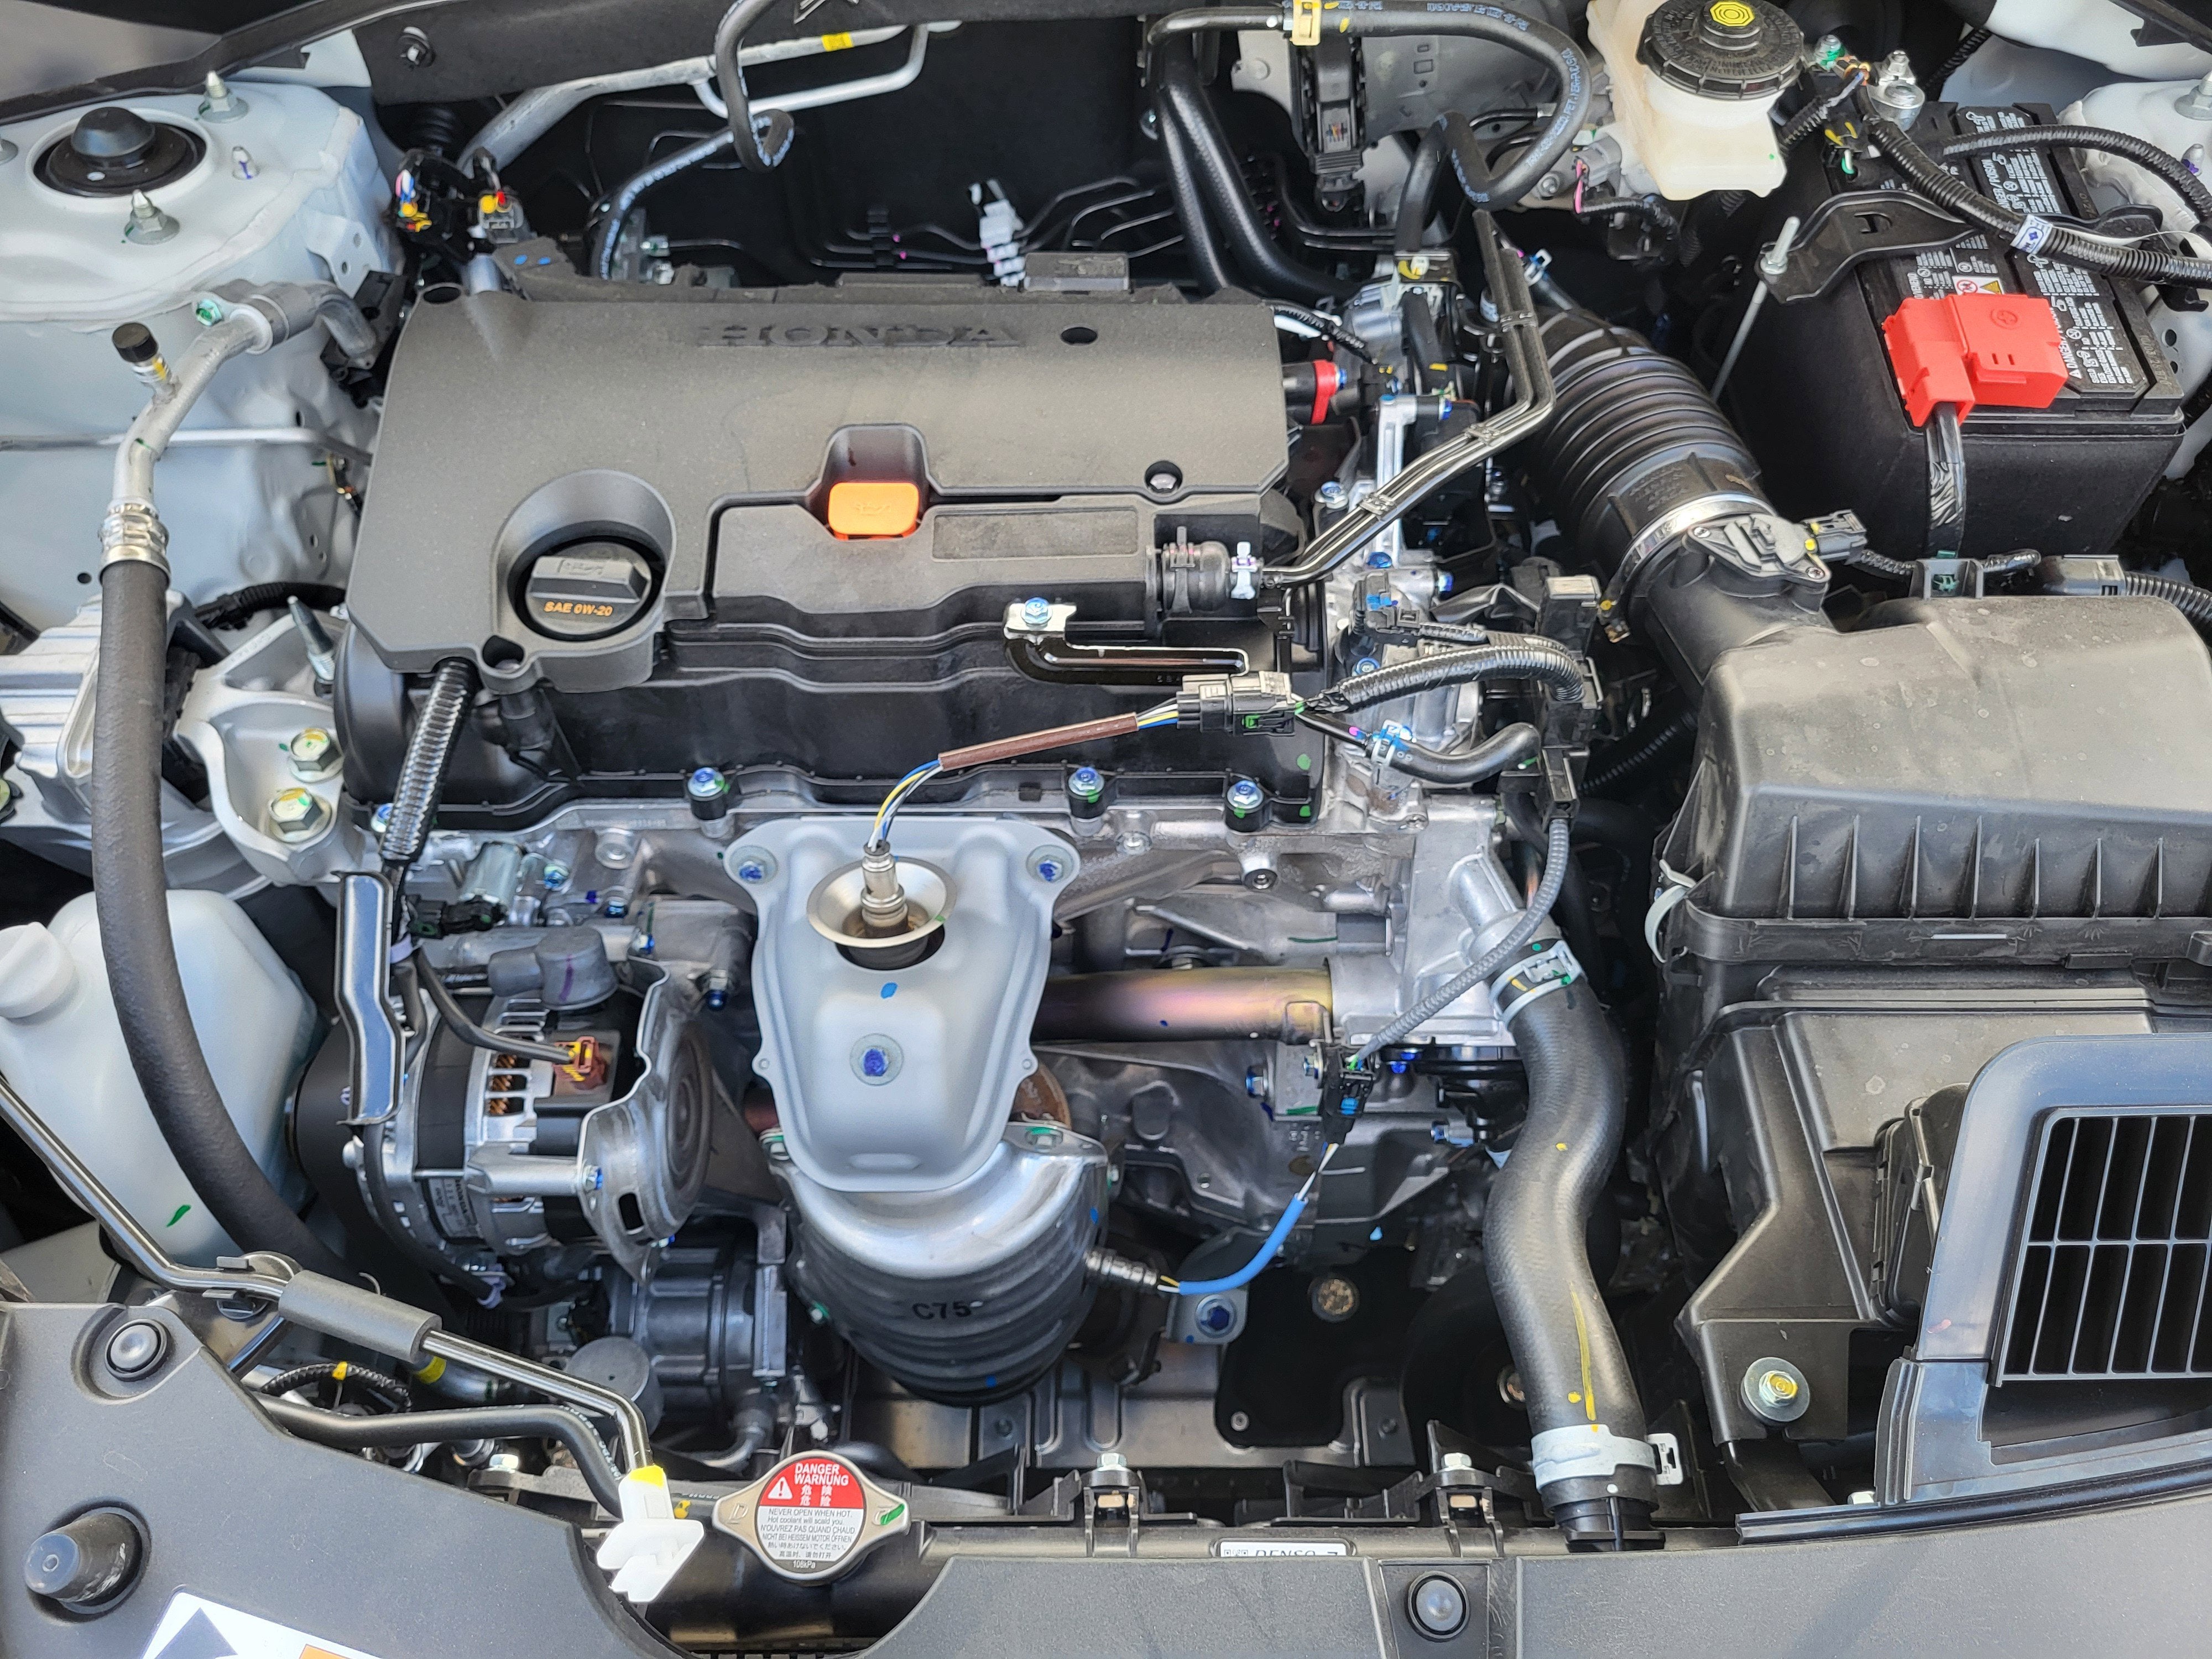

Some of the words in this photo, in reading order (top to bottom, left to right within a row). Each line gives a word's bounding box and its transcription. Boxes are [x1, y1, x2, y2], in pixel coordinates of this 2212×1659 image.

[698, 323, 1022, 347] HONDA
[544, 601, 573, 613] SAE
[573, 603, 613, 617] 0W-20
[912, 1301, 972, 1319] C75
[795, 1463, 840, 1474] DANGER
[794, 1474, 849, 1486] WARNUNG
